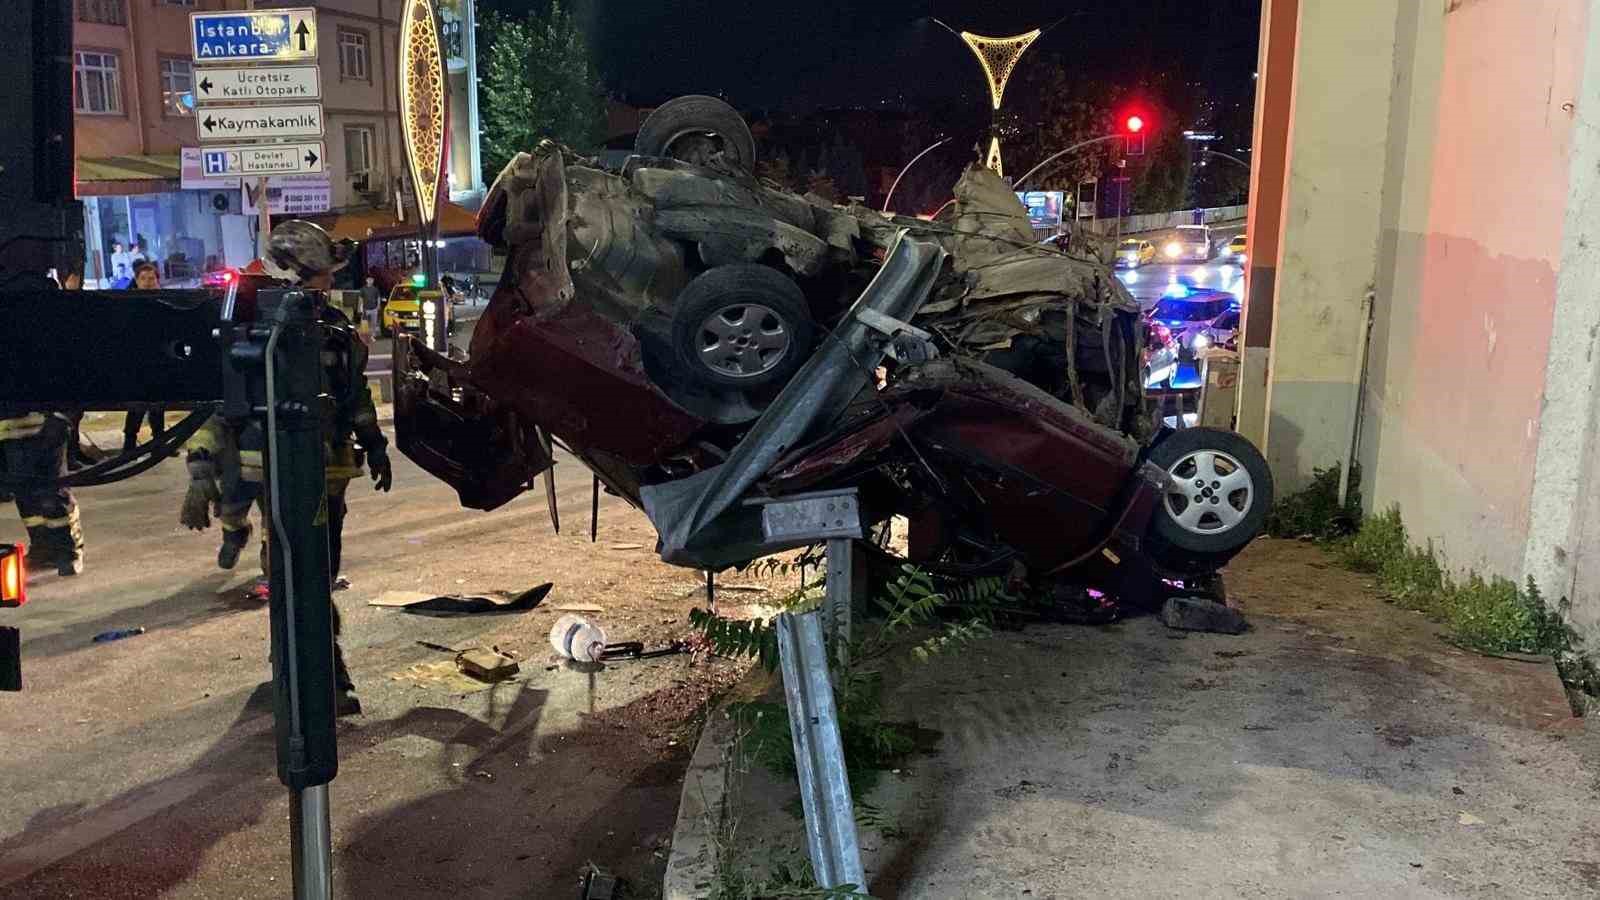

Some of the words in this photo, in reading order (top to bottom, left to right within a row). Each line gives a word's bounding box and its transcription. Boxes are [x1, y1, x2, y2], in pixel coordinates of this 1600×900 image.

[200, 41, 269, 56] Ankara
[256, 84, 307, 96] Otopark
[218, 115, 316, 132] Kaymakamlık
[254, 151, 284, 160] Devlet
